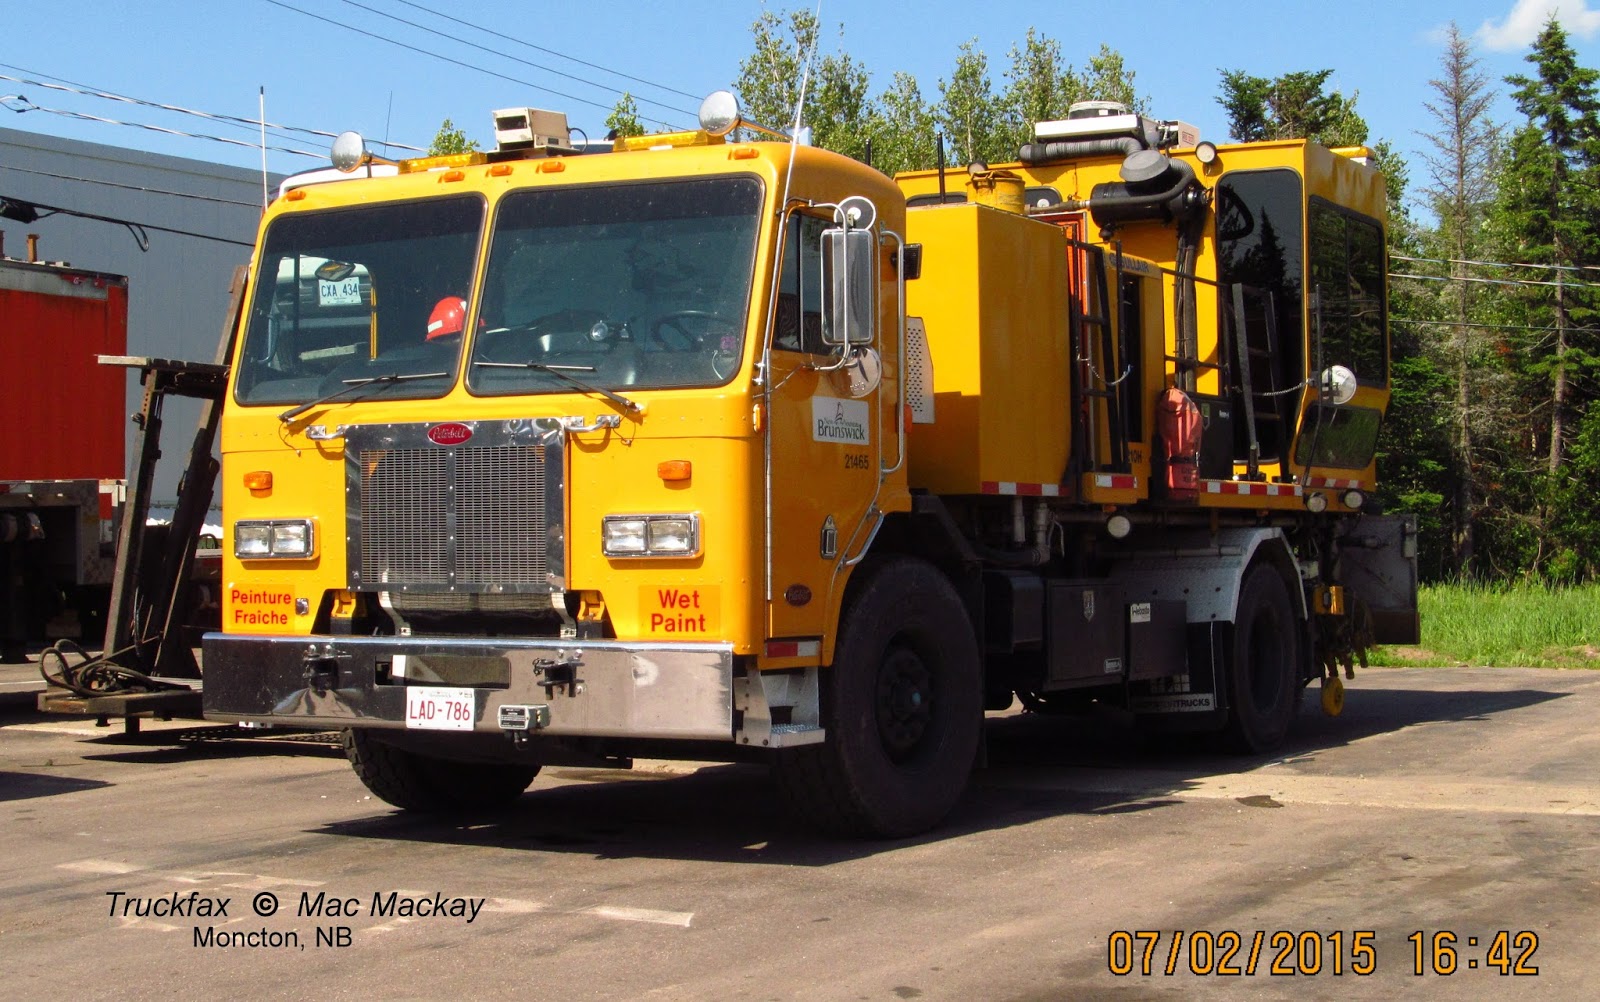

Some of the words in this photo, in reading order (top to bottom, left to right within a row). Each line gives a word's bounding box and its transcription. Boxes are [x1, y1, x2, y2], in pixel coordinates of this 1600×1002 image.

[321, 285, 337, 297] CXA
[342, 283, 358, 296] 434
[817, 419, 865, 440] Brunswick
[845, 454, 869, 469] 21465
[231, 589, 291, 604] Peinture
[658, 589, 700, 608] Wet
[235, 609, 288, 624] Fraiche
[651, 613, 706, 632] Paint
[409, 700, 471, 721] LAD-786
